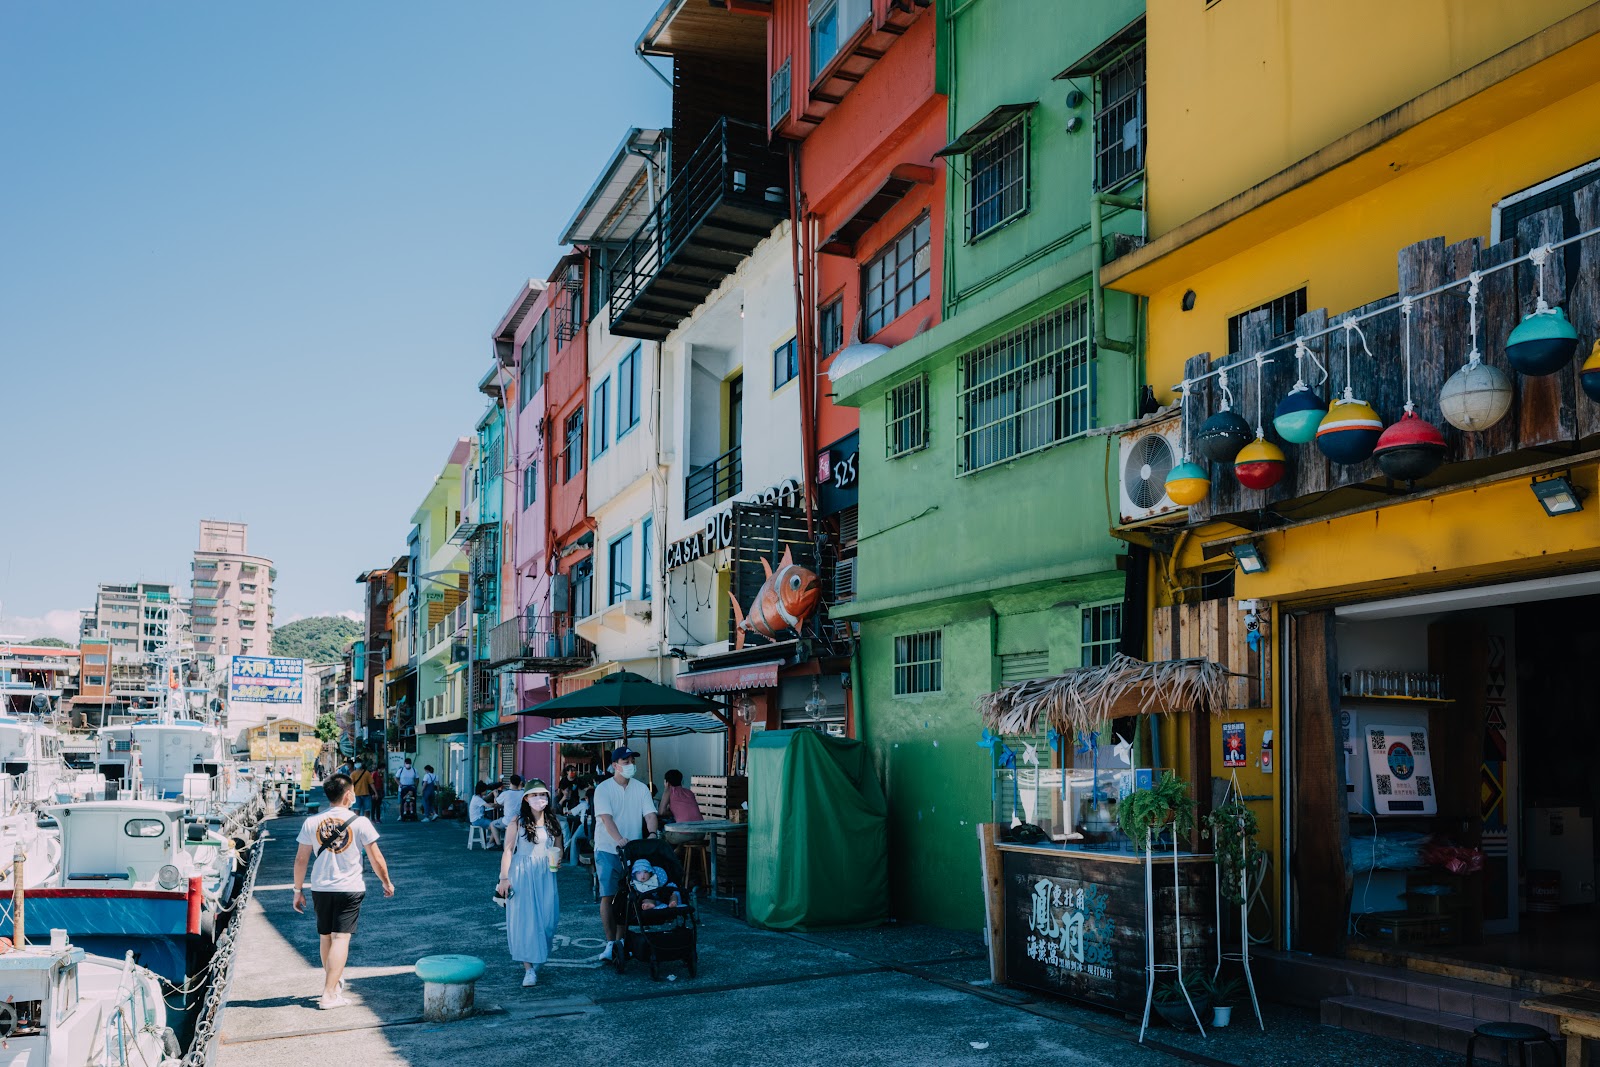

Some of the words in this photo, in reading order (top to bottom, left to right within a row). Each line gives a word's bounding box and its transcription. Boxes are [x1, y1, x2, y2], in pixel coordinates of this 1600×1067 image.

[834, 453, 855, 488] 525
[666, 534, 701, 568] CASA
[1053, 885, 1084, 910] 東北角
